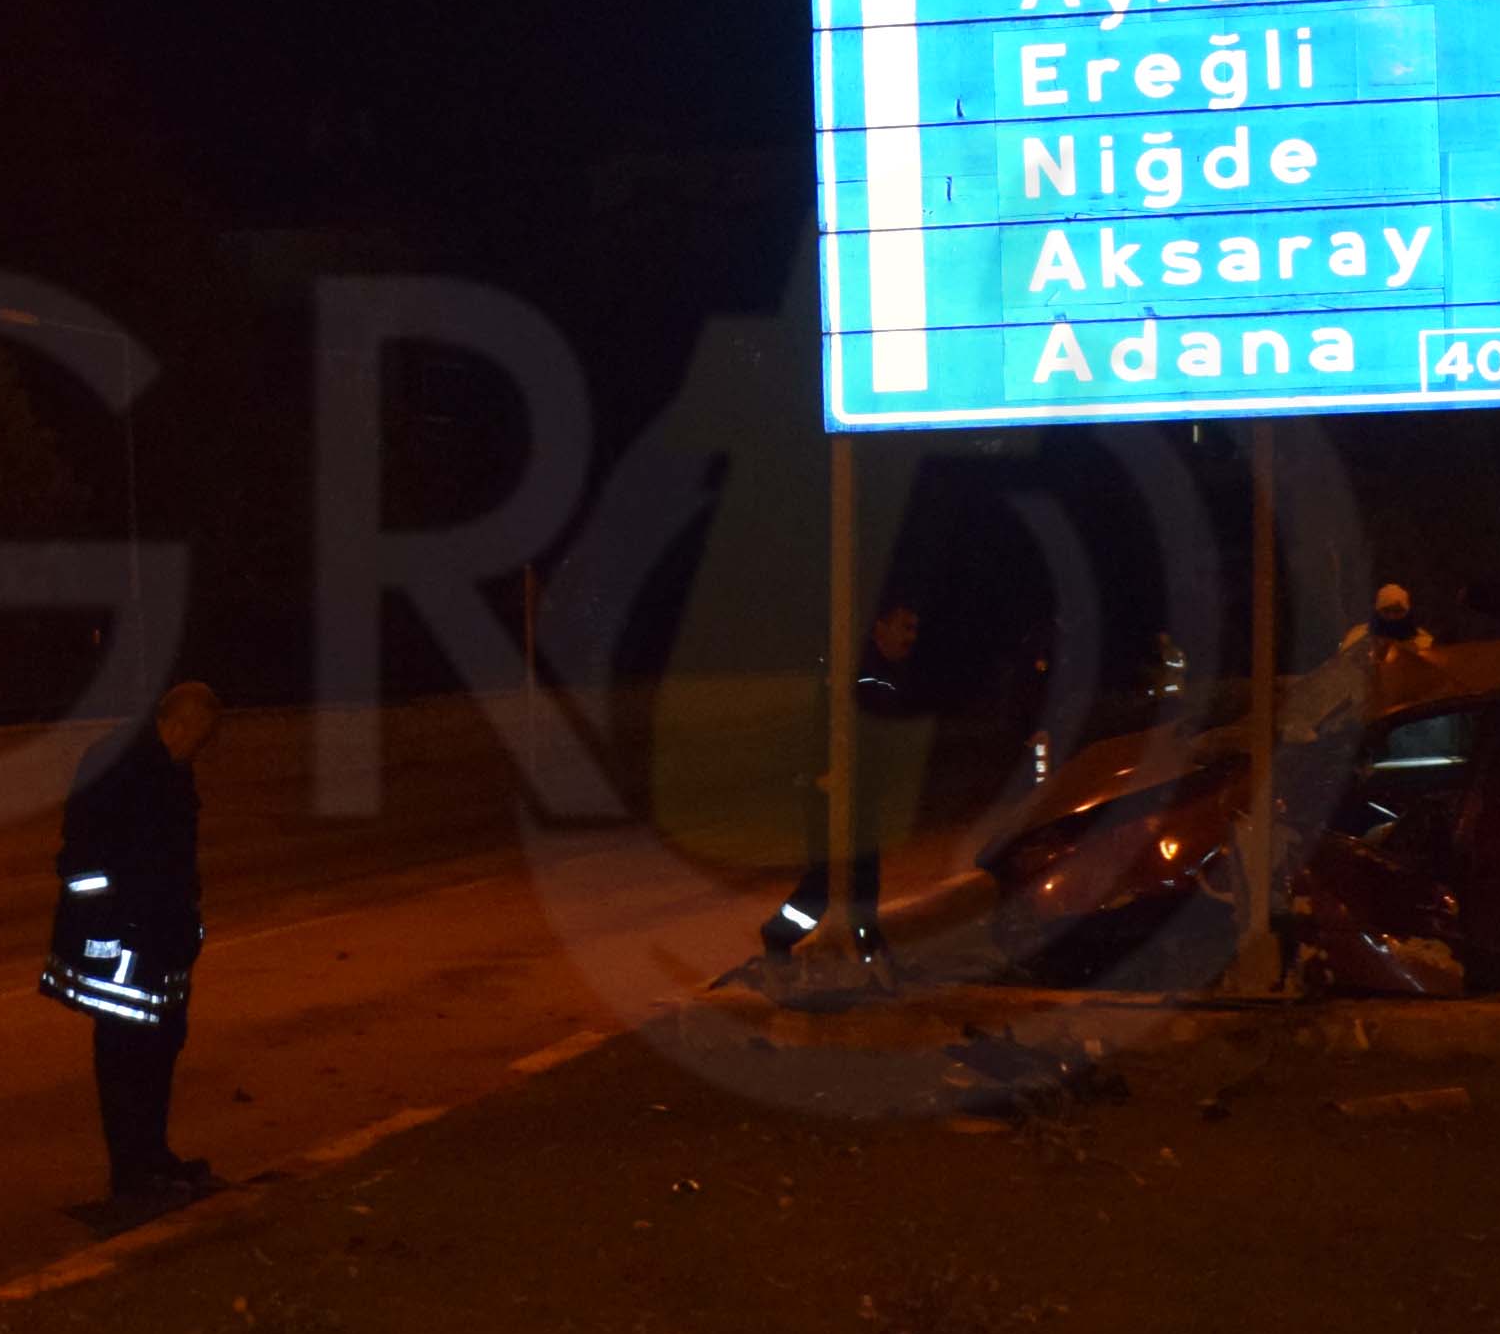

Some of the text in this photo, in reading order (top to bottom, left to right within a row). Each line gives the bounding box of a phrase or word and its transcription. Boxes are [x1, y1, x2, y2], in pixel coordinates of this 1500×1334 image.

[1020, 26, 1314, 110] Ereğli
[1021, 125, 1318, 210] Niğde
[1028, 225, 1433, 294] Aksaray
[1031, 318, 1355, 385] Adana
